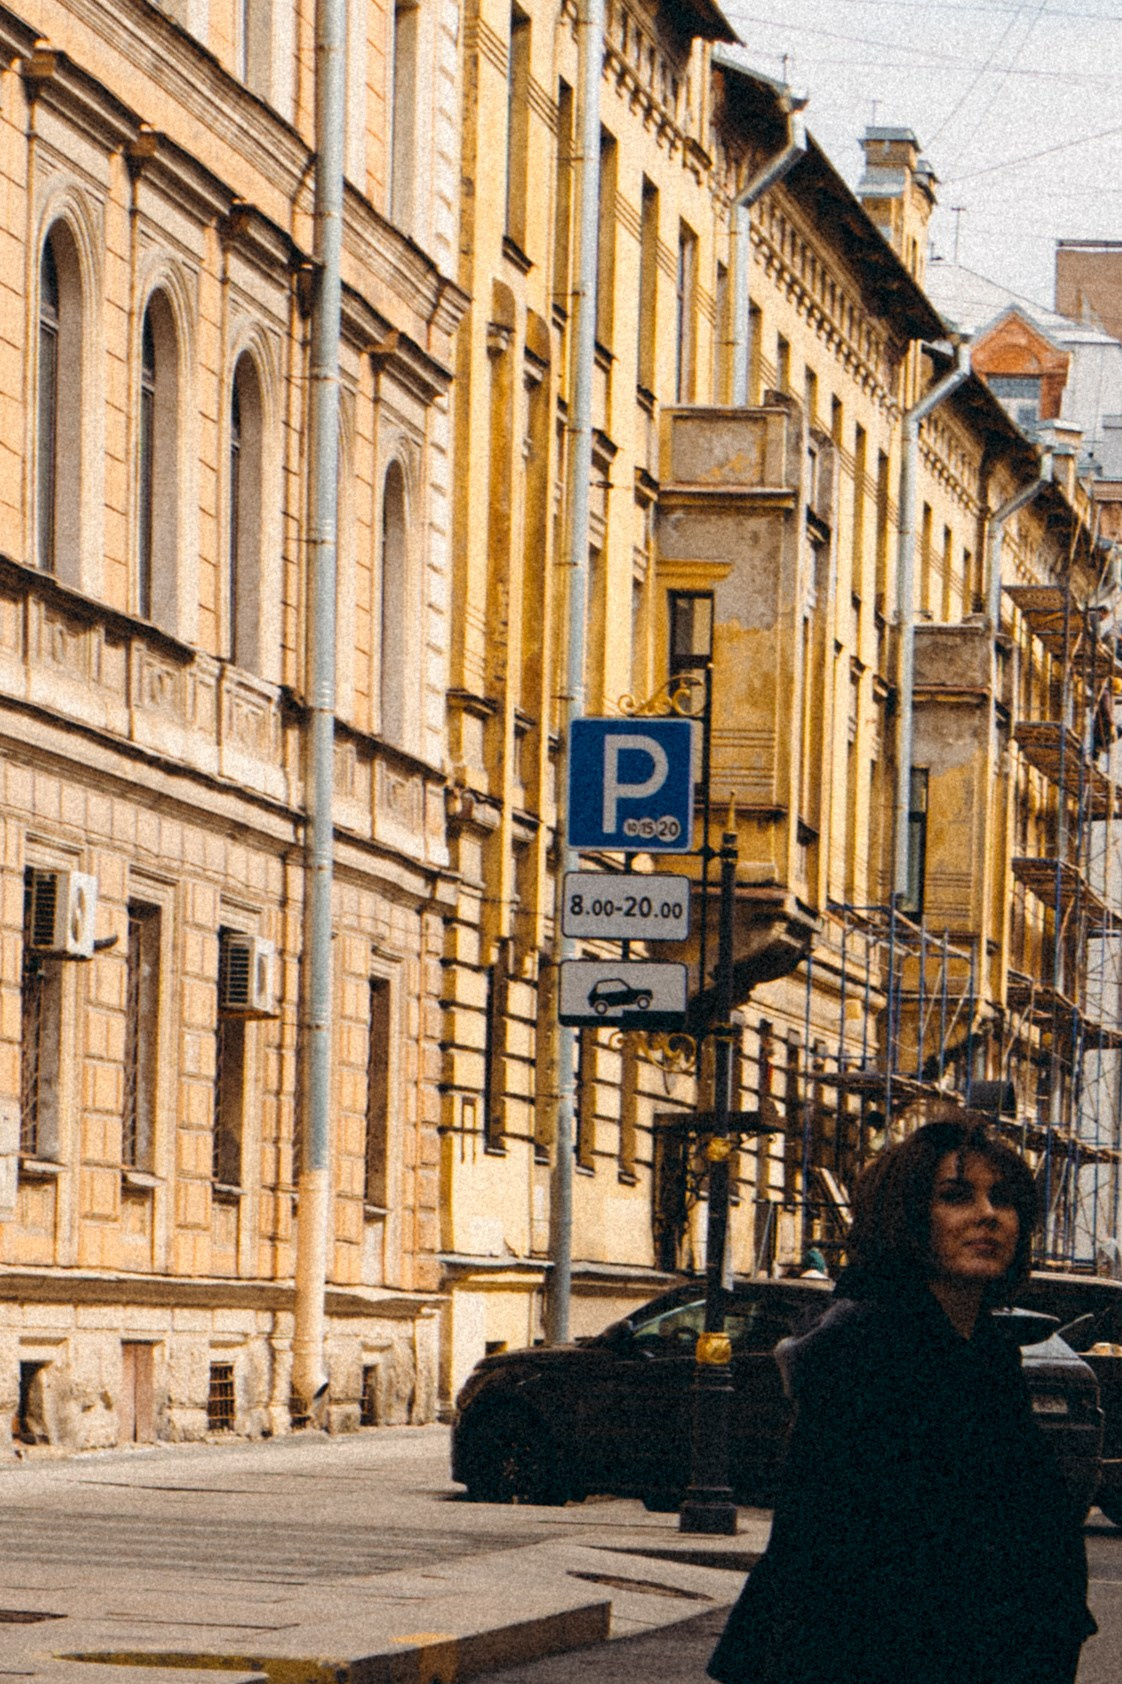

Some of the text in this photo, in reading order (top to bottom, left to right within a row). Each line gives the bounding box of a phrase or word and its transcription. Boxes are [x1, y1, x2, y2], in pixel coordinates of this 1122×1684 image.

[602, 734, 669, 834] P
[641, 822, 654, 834] 15
[658, 821, 679, 837] 20
[570, 894, 683, 919] 8.00-20.00
